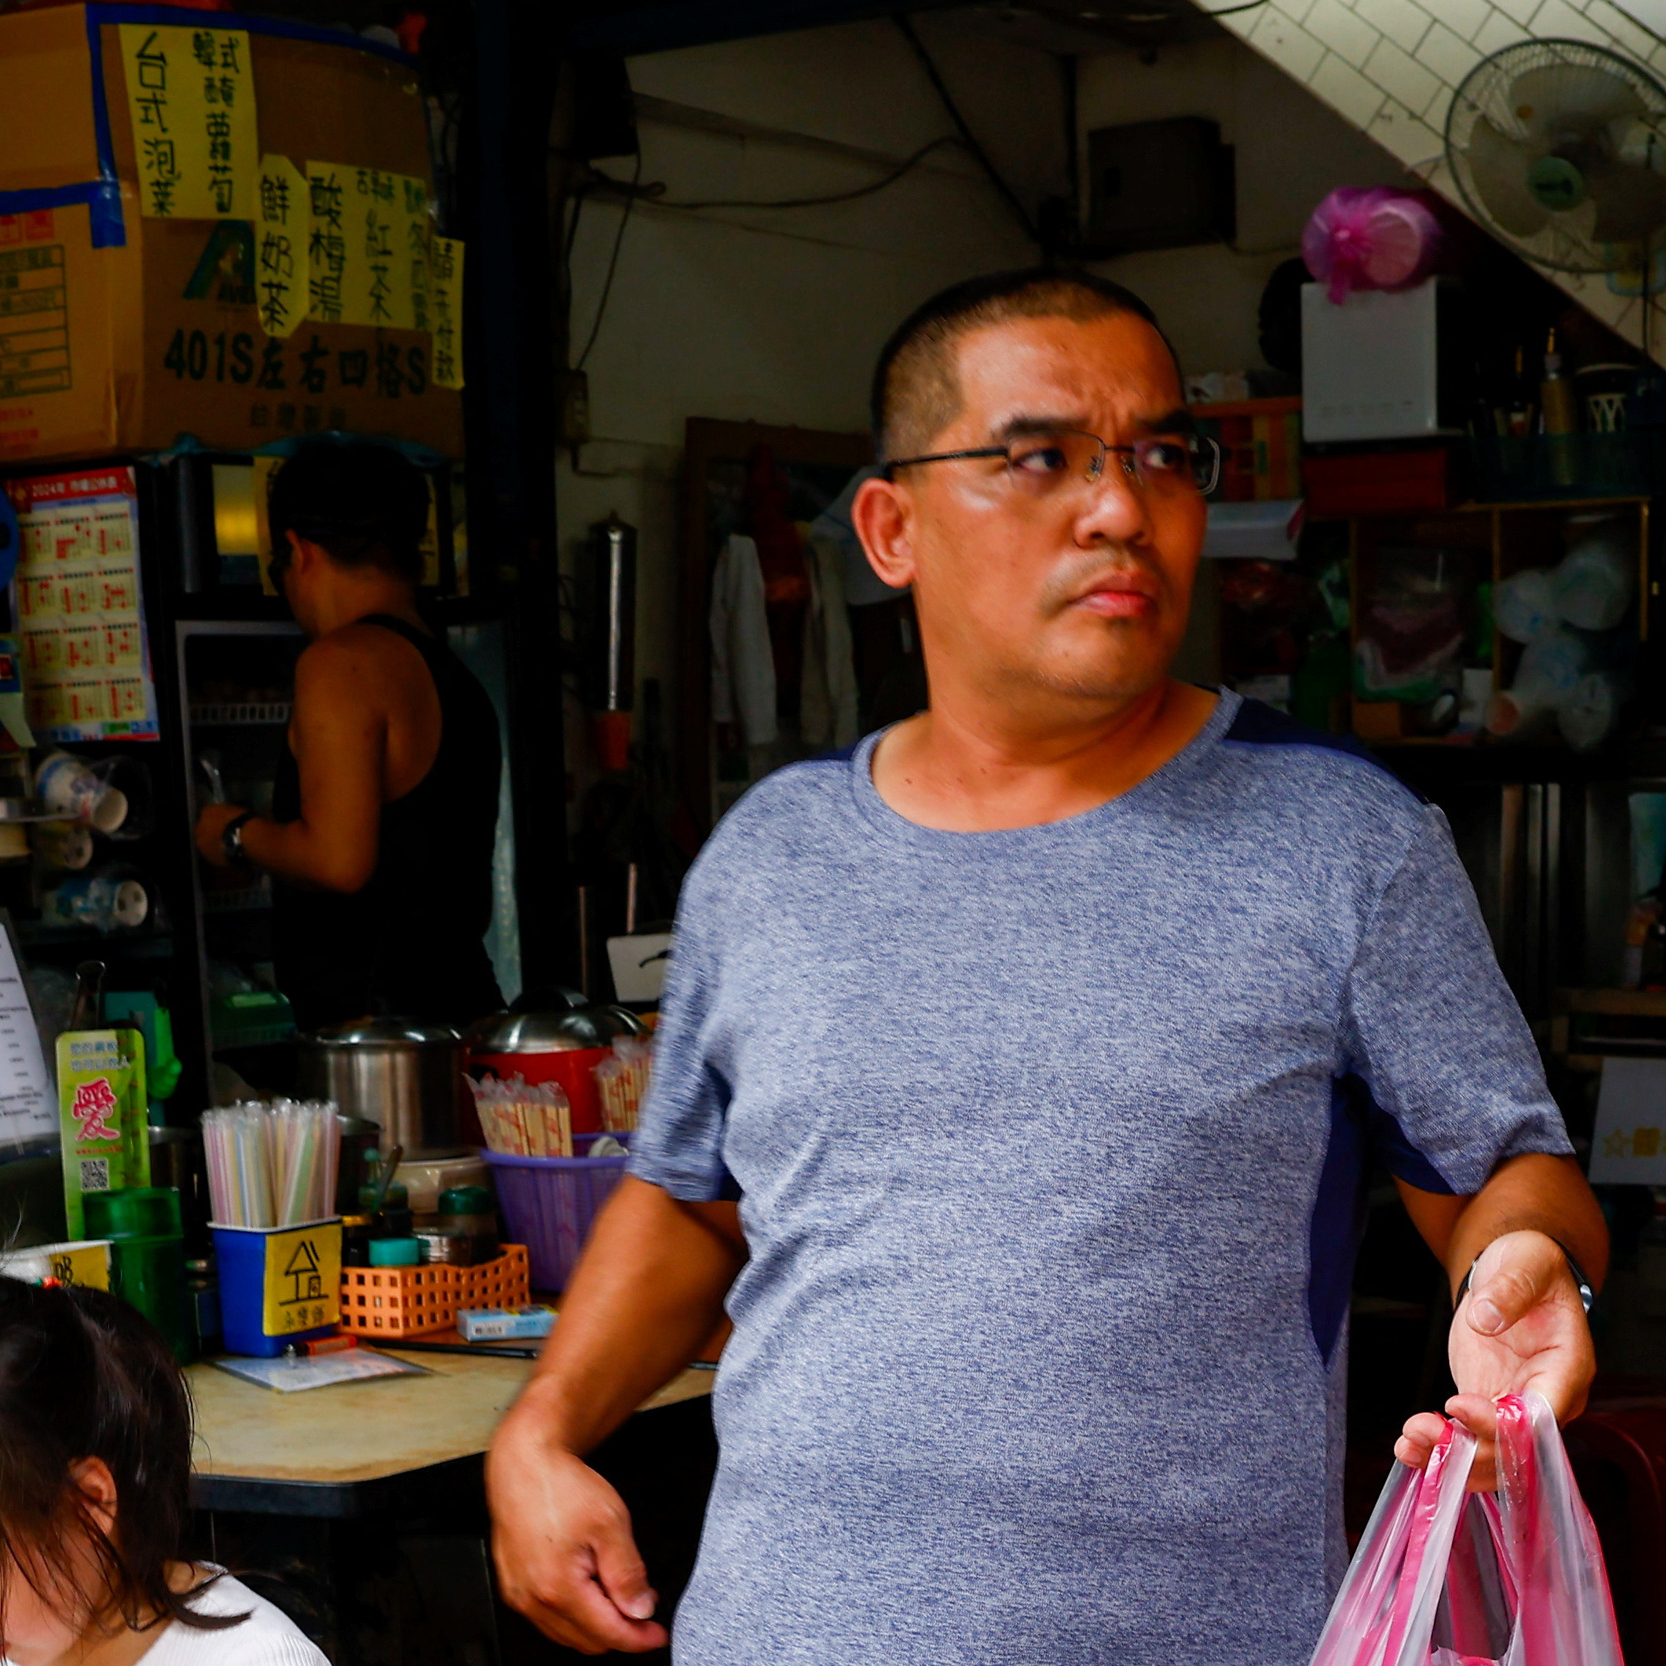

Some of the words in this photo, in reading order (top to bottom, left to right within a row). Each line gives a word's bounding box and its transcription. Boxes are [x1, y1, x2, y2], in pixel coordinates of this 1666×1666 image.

[134, 30, 181, 216] 台式泡菜
[259, 174, 296, 332] 鮮奶茶
